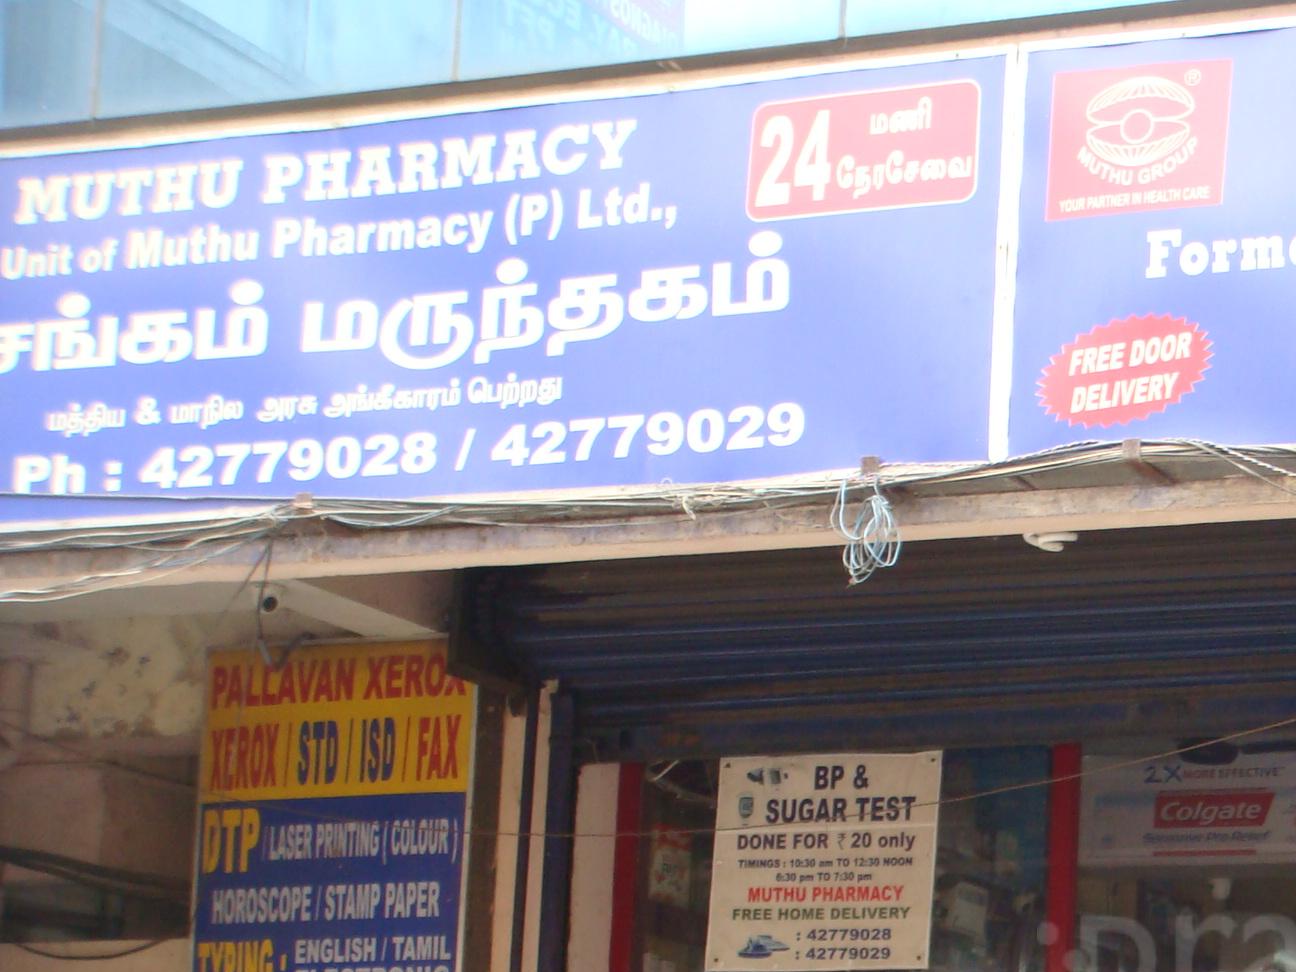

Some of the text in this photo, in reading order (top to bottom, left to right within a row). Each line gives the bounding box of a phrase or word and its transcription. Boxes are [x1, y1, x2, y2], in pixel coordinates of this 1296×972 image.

[870, 97, 932, 136] மணி
[14, 119, 637, 224] MUTHU PHARMACY
[755, 109, 830, 208] 24
[1077, 136, 1198, 186] MUTHU GROUP
[1, 183, 677, 279] Unit of Muthu Pharmacy (P) Ltd.,
[301, 230, 790, 370] மருந்தகம்
[1069, 331, 1193, 377] FREE DOOR
[1070, 371, 1180, 414] DELIVERY
[46, 402, 127, 437] மத்திய
[133, 395, 161, 425] &
[170, 394, 244, 429] மாநில
[14, 402, 805, 494] Ph 42779028 42779029
[212, 657, 356, 710] PALLAVAN
[210, 714, 462, 791] XEROX STD ISD FAX
[814, 764, 869, 790] BP &
[765, 796, 917, 824] SUGAR TEST
[1159, 800, 1262, 827] Colgate
[203, 808, 380, 874] DTP LASER PRINTING
[736, 833, 786, 850] DONE
[792, 833, 829, 848] FOR
[851, 832, 871, 848] 20
[878, 832, 916, 851] only
[738, 859, 781, 869] TIMINGS
[837, 858, 850, 867] TO
[883, 857, 913, 867] NOON
[817, 872, 830, 881] TO
[211, 882, 440, 925] HOROSCOPE STAMP PAPER
[732, 906, 911, 921] FREE HOME DELIVERY
[747, 885, 904, 903] MUTHU PHARMACY
[294, 937, 376, 964] ENGLISH
[392, 936, 451, 961] TAMIL
[805, 948, 891, 960] 42779029
[806, 929, 891, 941] 42779028
